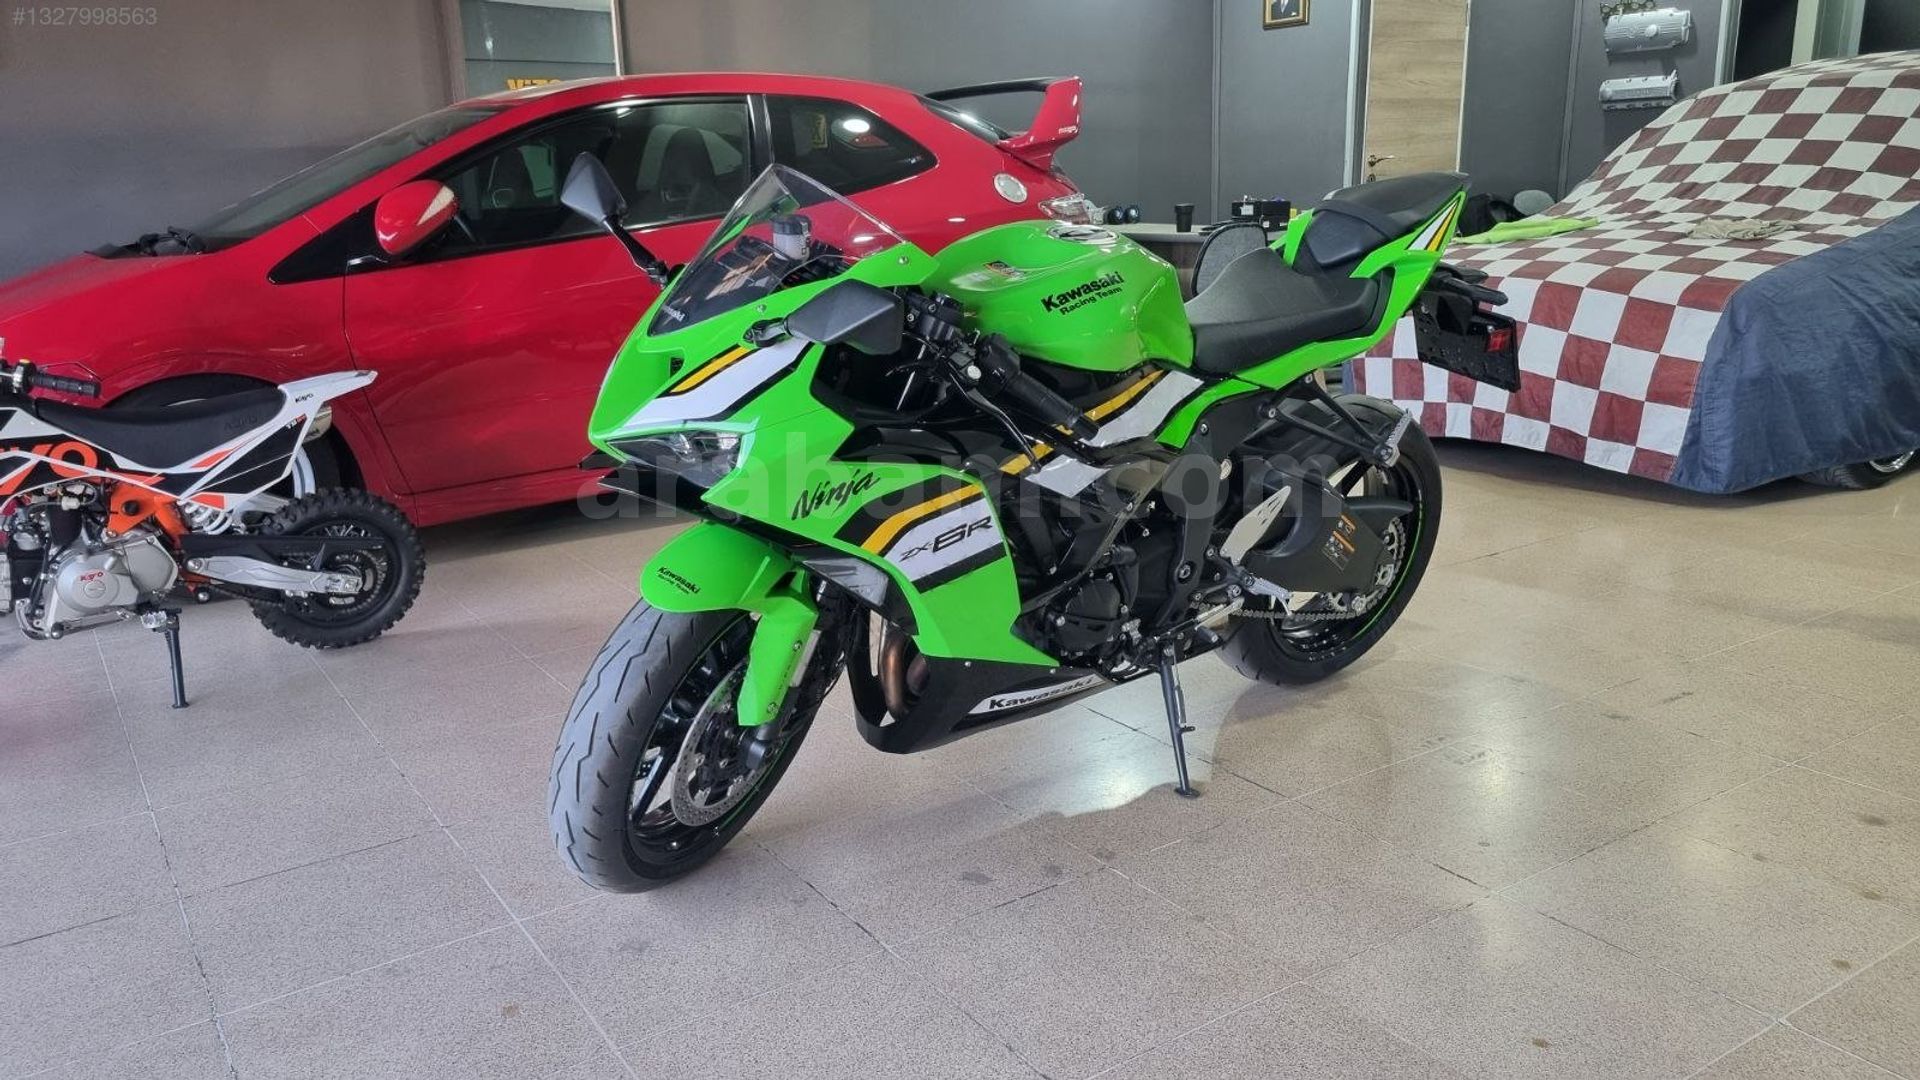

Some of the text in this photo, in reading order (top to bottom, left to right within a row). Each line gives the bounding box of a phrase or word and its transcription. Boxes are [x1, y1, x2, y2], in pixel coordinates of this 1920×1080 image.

[1041, 271, 1124, 312] Kawasaki
[1059, 286, 1123, 315] Racing Team
[791, 469, 881, 521] Ninja
[898, 516, 993, 563] ZX-6R
[657, 566, 701, 594] Kawasaki
[988, 677, 1093, 710] Kawasaki
